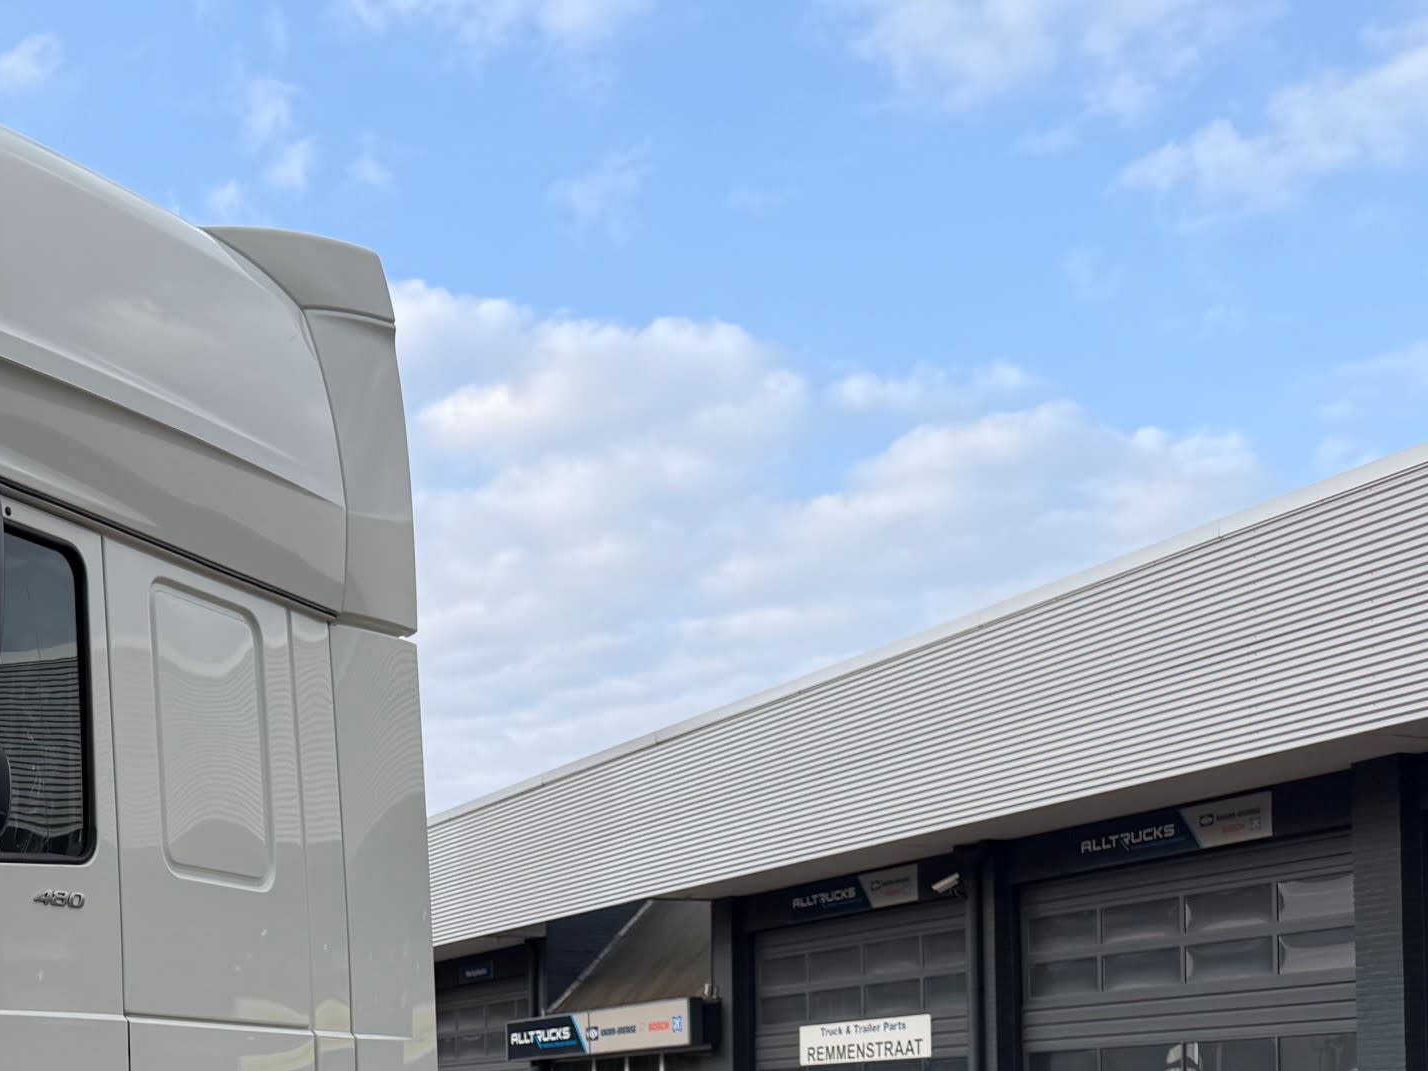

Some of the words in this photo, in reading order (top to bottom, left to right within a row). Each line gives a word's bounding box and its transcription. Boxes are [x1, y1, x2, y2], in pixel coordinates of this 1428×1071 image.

[1080, 823, 1175, 853] ALLTRUCKS
[33, 889, 85, 909] 480
[510, 1026, 571, 1047] ALLTRUCKS
[821, 1027, 842, 1037] Truck
[846, 1026, 851, 1034] &
[854, 1023, 881, 1034] Trailer
[883, 1021, 906, 1031] Parts
[807, 1039, 923, 1061] REMMENSTRAAT
